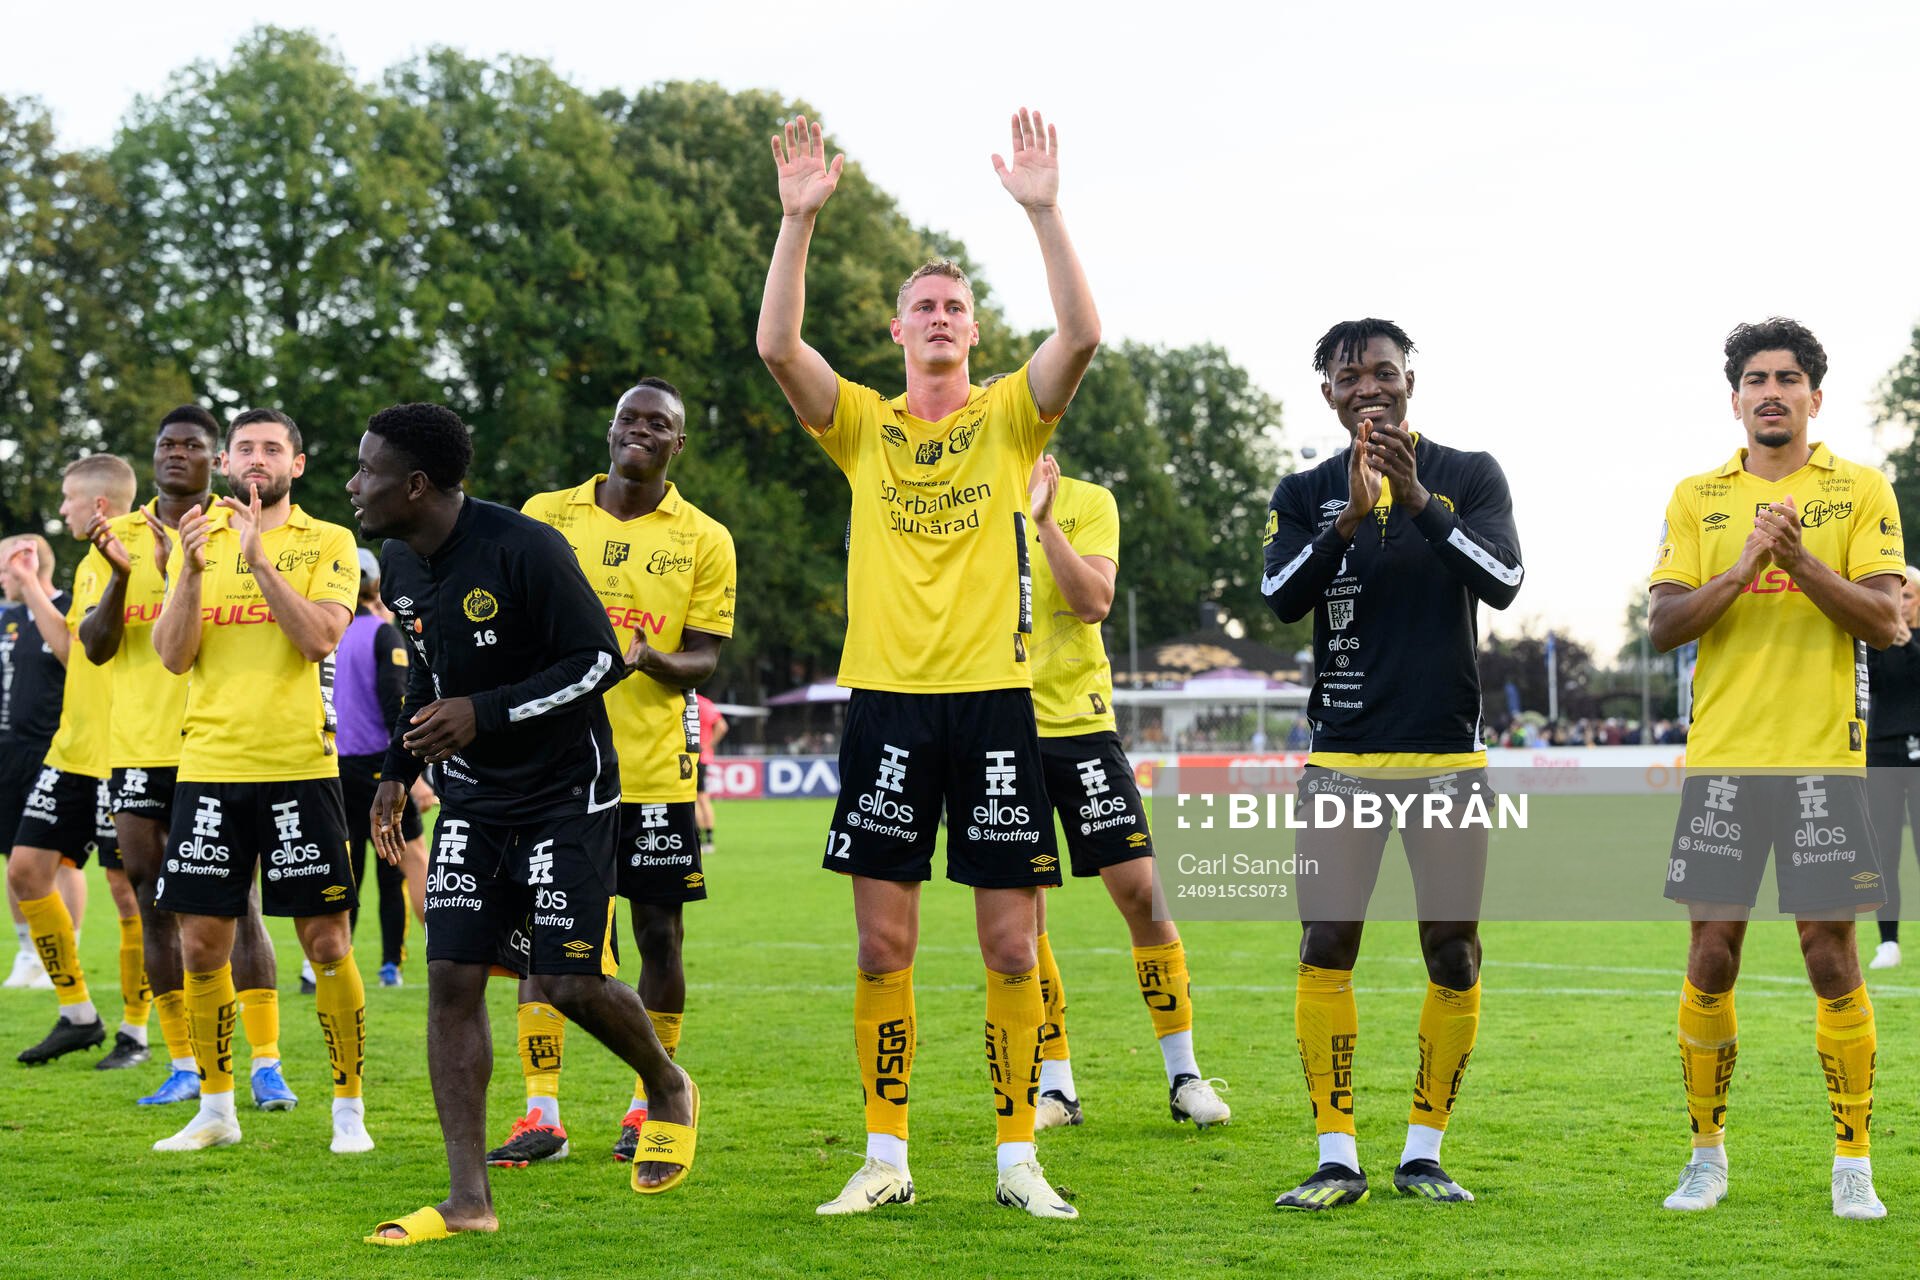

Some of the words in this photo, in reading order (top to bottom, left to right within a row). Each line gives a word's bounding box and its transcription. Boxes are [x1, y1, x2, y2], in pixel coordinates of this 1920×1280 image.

[1705, 524, 1726, 532] umbro
[646, 550, 692, 576] Elfsborg
[1324, 584, 1362, 597] ULSEN
[605, 606, 666, 635] SEN
[1331, 610, 1352, 620] EKT
[473, 629, 498, 647] 16
[858, 790, 914, 824] ellos
[973, 799, 1030, 825] ellos
[1079, 796, 1127, 820] ellos
[861, 818, 918, 843] Skrotfrag
[1092, 814, 1137, 832] Skrotfrag
[1690, 811, 1742, 841] ellos
[635, 830, 683, 851] ellos
[826, 830, 852, 859] 12
[983, 828, 1040, 843] Skrotfrag
[1795, 822, 1846, 847] ellos
[178, 836, 230, 862] ellos
[271, 841, 321, 865] ellos
[1692, 839, 1743, 861] Skrotfrag
[1802, 849, 1856, 864] Skrotfrag
[180, 862, 230, 879] Skrotfrag
[283, 863, 330, 878] Skrotfrag
[642, 854, 693, 867] Skrotfrag
[1033, 865, 1055, 873] umbro
[1666, 858, 1687, 882] 18
[155, 877, 165, 900] 9
[426, 865, 477, 893] ellos
[429, 894, 483, 911] Skrotfrag
[565, 951, 590, 959] umbro
[876, 1018, 909, 1106] OSGA
[645, 1146, 673, 1154] umbro
